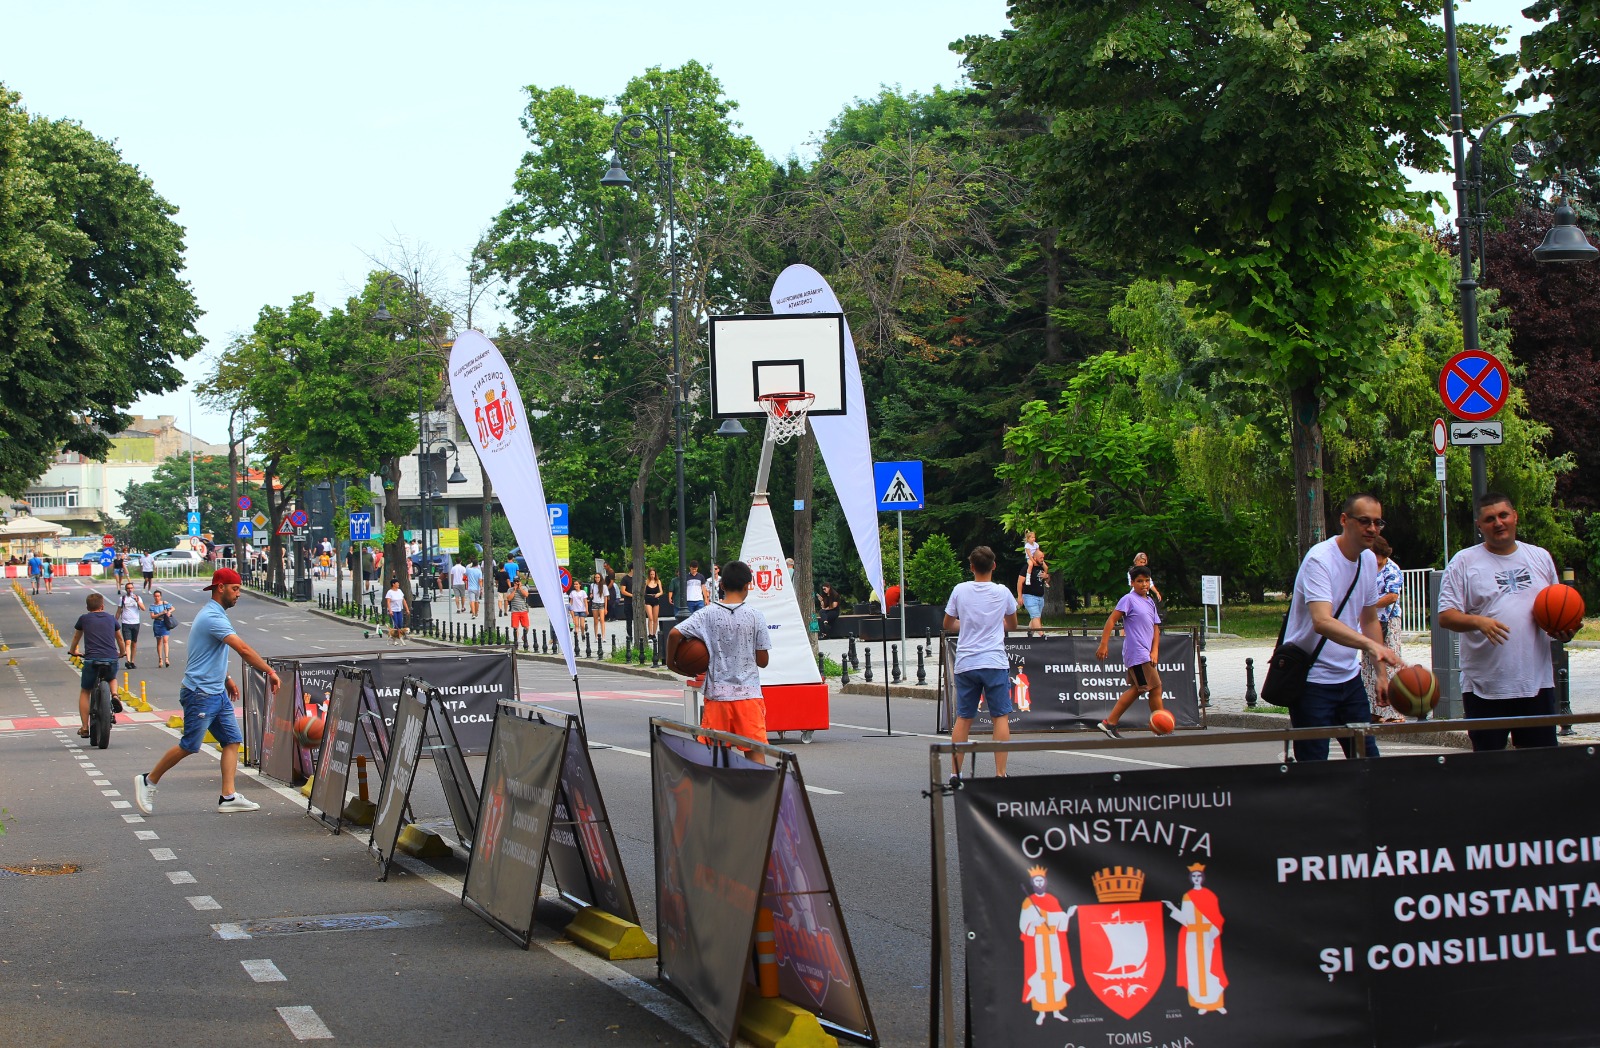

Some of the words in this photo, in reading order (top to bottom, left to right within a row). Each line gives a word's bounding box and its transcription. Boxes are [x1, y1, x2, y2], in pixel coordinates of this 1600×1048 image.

[549, 507, 563, 525] P
[1045, 662, 1102, 673] PRIMĂRIA
[1104, 663, 1185, 673] MUNULUI
[301, 677, 333, 690] TANȚA
[1082, 677, 1132, 687] CONSTA
[1058, 692, 1070, 703] ȘI
[1073, 691, 1122, 701] CONSILI
[1139, 691, 1176, 700] LOAL
[453, 713, 494, 724] LOCAL
[997, 798, 1093, 818] PRIMĂRIA
[1098, 791, 1232, 813] MUNICIPIULUI
[1021, 818, 1212, 858] CONSTANȚA
[1277, 845, 1455, 883] PRIMĂRIA
[1394, 882, 1600, 922] CONSTANȚA
[1319, 947, 1354, 982] ȘI
[1367, 931, 1556, 970] CONSILIUL
[1106, 1031, 1152, 1045] TOMIS
